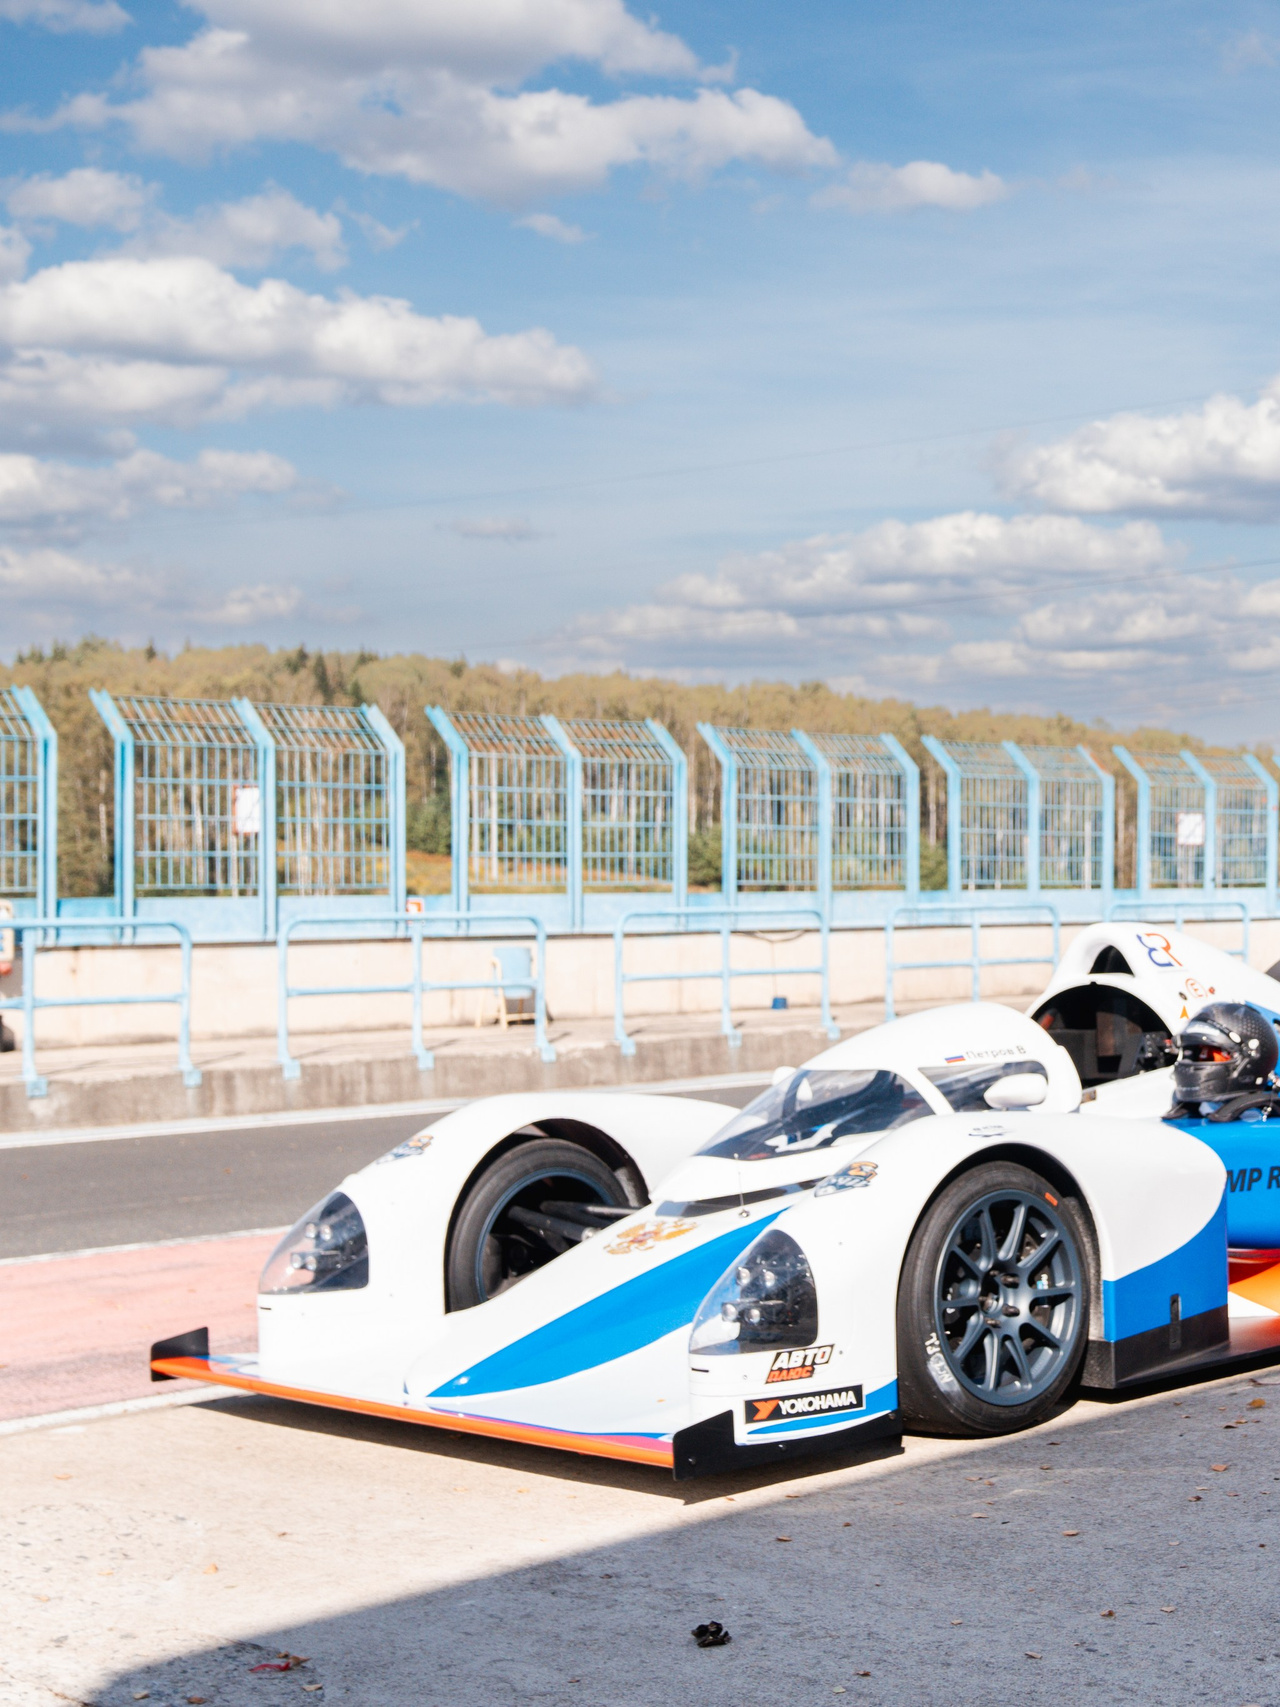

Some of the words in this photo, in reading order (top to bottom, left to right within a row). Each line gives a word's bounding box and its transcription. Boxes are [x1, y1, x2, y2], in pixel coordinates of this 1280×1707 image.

[1226, 1167, 1262, 1193] MP
[771, 1346, 832, 1371] АВТО
[778, 1390, 858, 1416] YOKOHAMA
